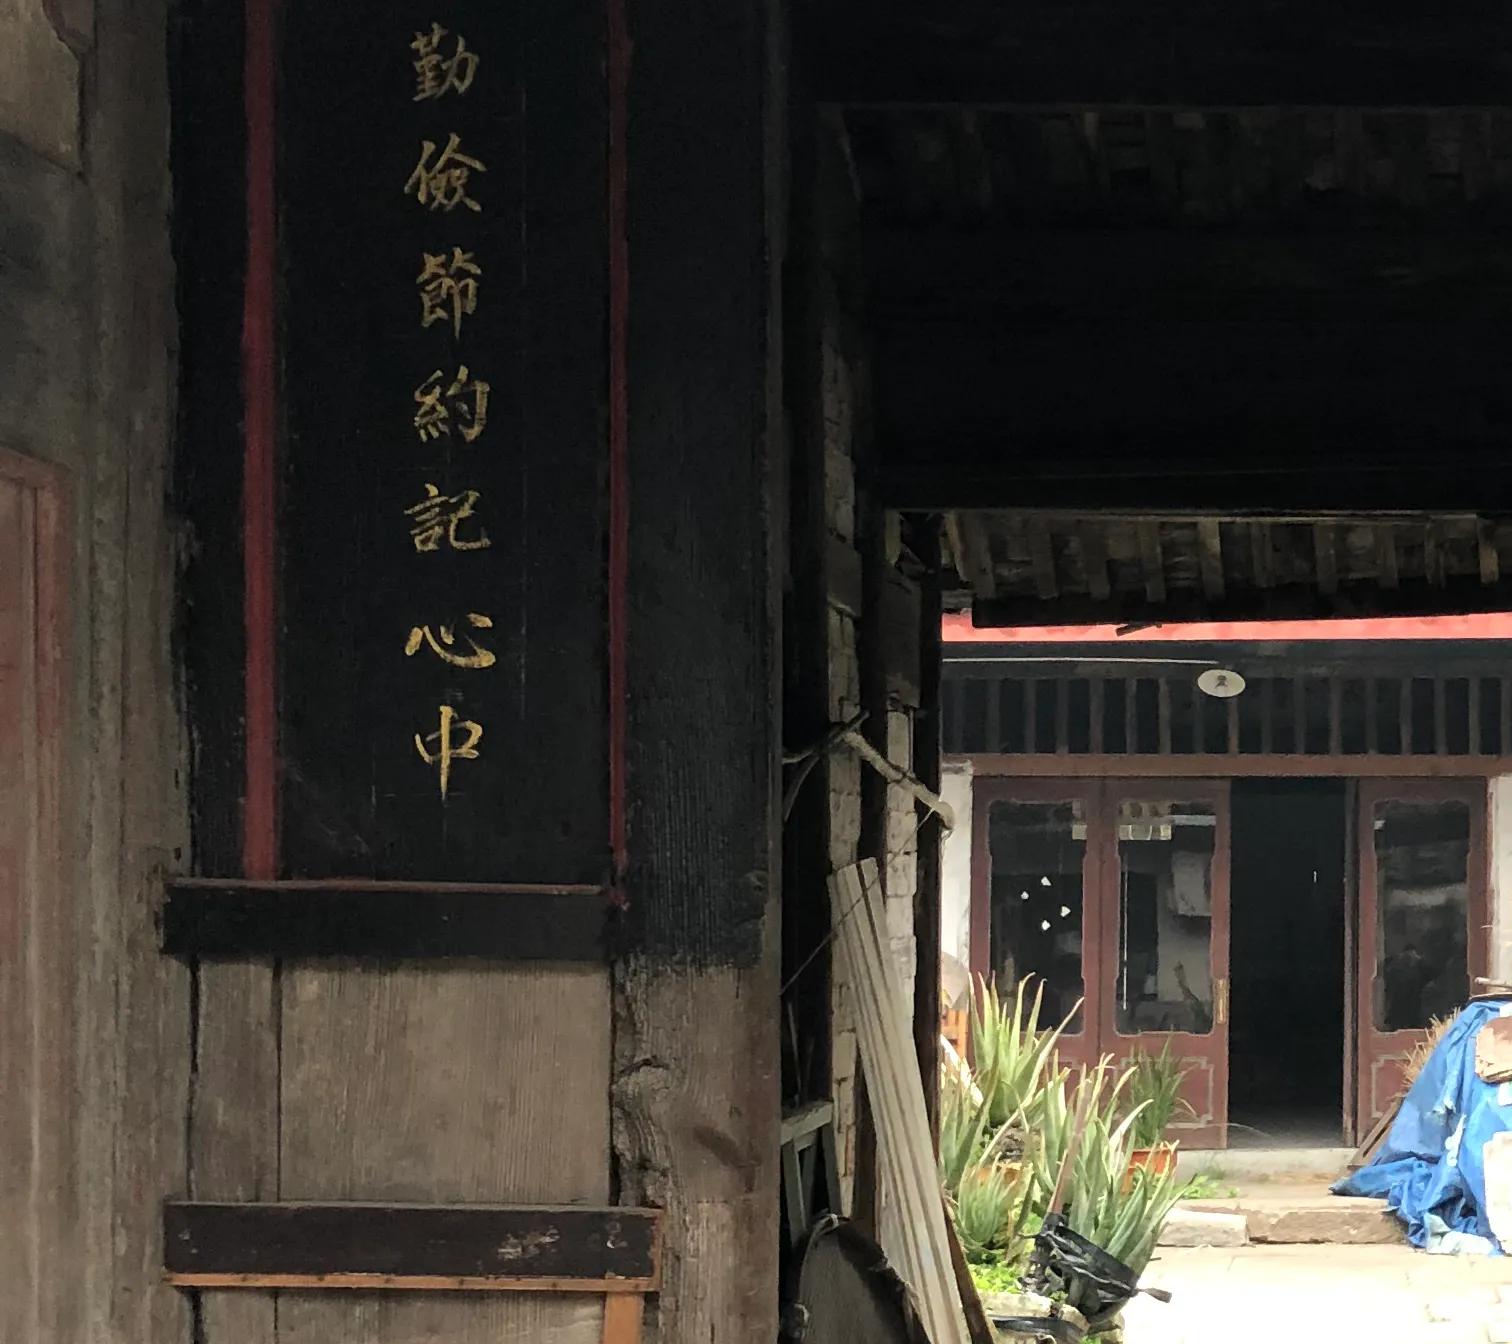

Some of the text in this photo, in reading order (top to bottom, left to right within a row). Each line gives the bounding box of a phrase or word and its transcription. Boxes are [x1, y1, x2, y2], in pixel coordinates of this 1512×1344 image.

[404, 22, 496, 800] 勤儉節約記心中
